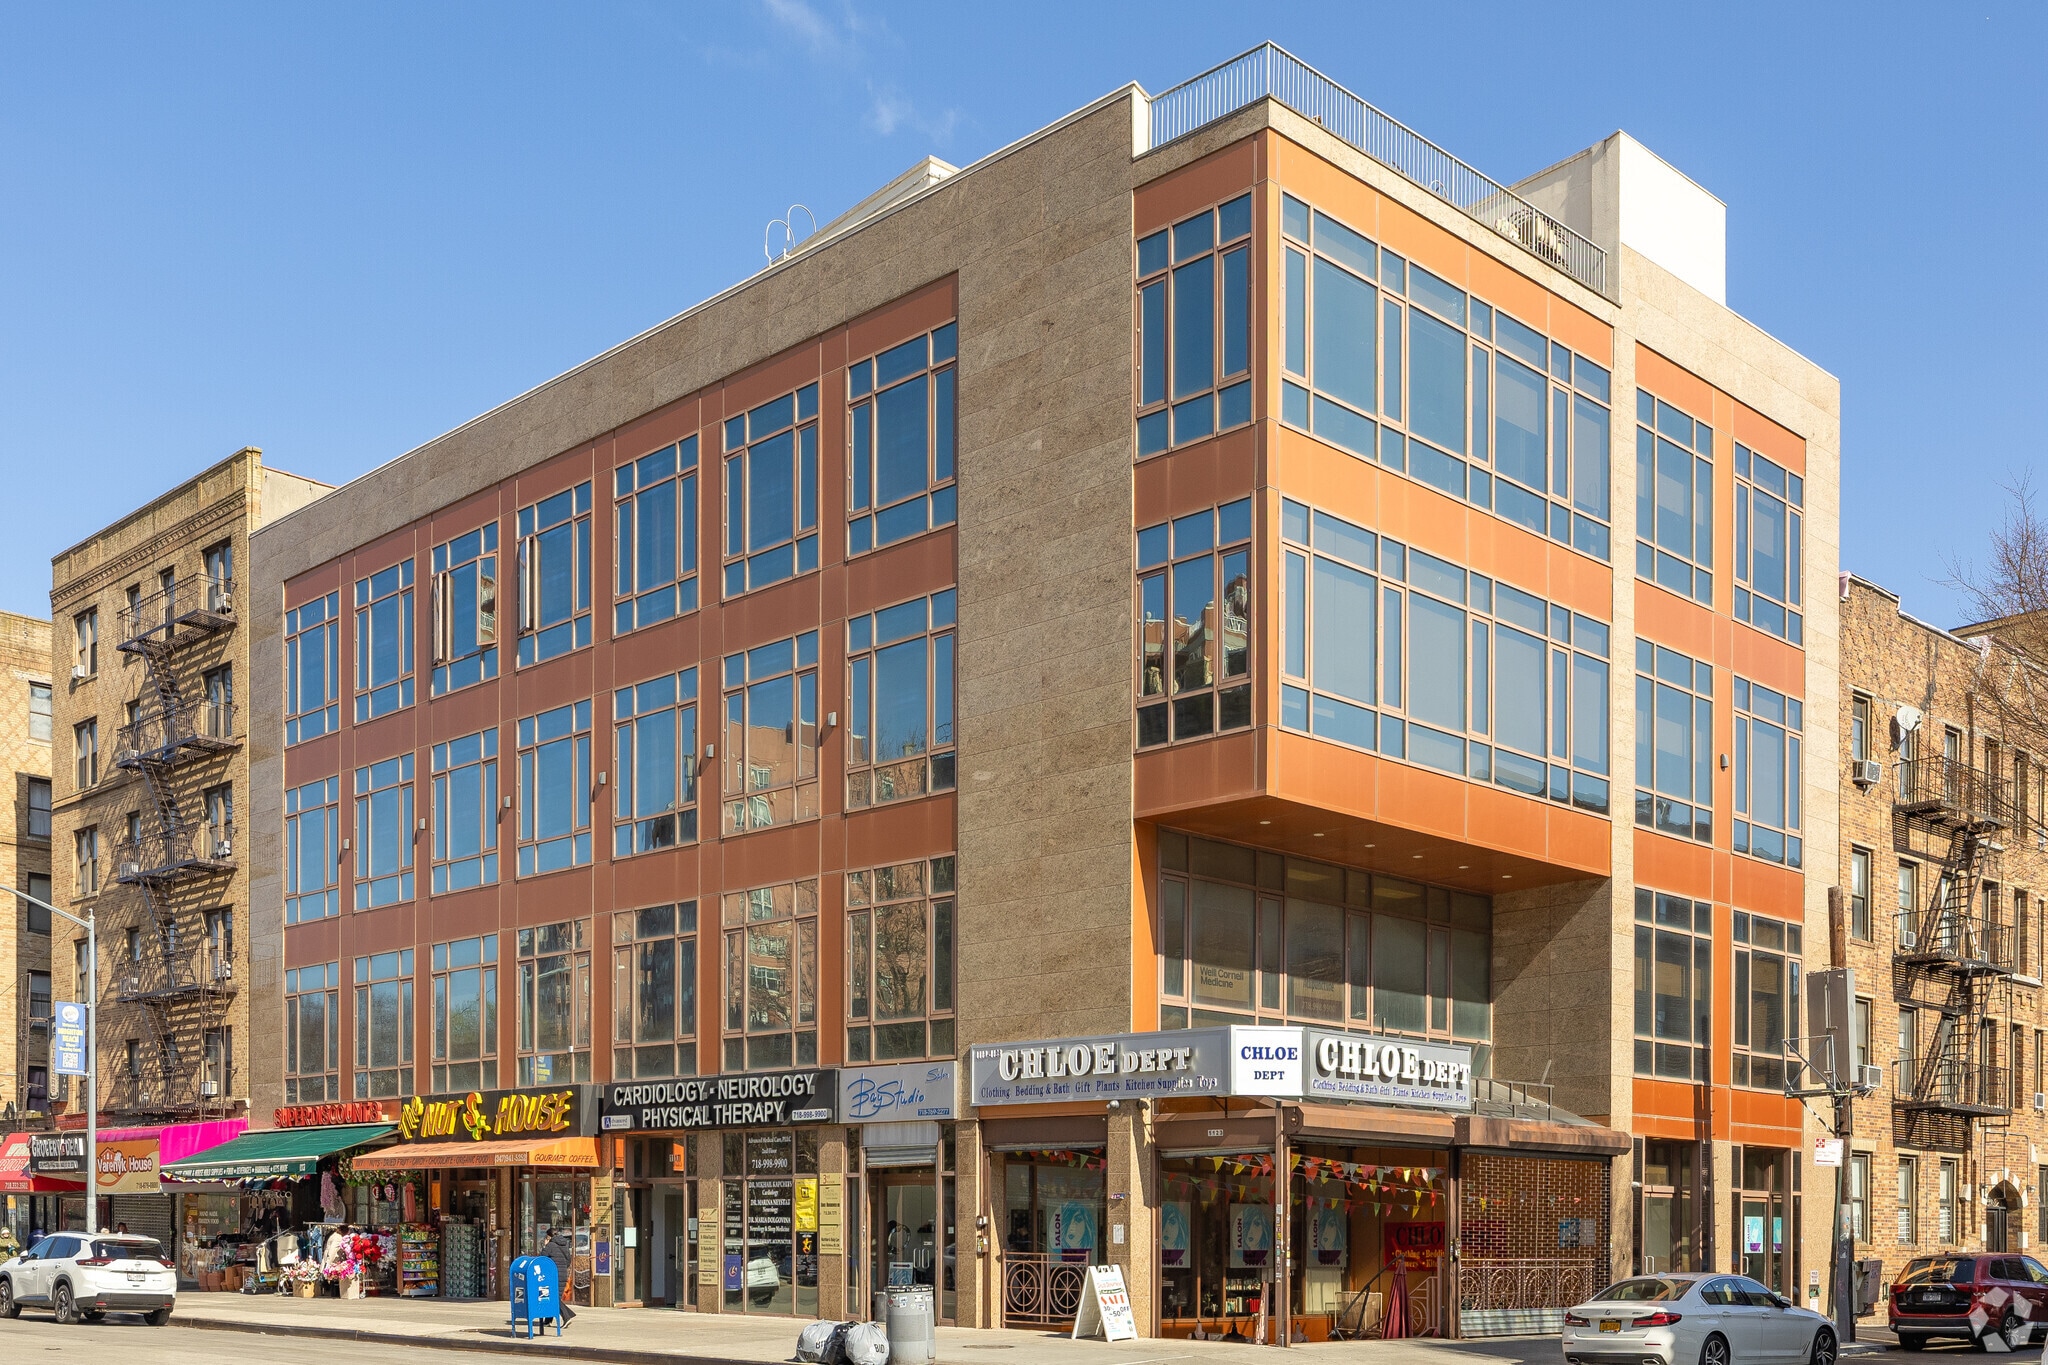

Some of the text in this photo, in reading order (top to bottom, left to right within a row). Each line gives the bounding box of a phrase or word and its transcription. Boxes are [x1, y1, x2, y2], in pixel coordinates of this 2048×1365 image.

[1200, 976, 1233, 988] Medicine
[1217, 968, 1244, 981] Cornell
[1000, 1042, 1190, 1081] CHLOE DEPT
[1241, 1046, 1298, 1061] CHLOE
[1319, 1037, 1472, 1085] CHLOE DEPT
[1254, 1070, 1285, 1080] DEPT
[613, 1081, 707, 1107] CARDIOLOGY
[717, 1073, 815, 1100] NEUROLOGY
[981, 1075, 1217, 1099] Clothing Bedding & Bath Gift Plants Kitchen Supplies Toys
[1312, 1079, 1336, 1093] Clothing
[1338, 1081, 1359, 1094] Bedding
[1365, 1084, 1377, 1094] Bath
[1379, 1085, 1390, 1095] Gift
[1393, 1087, 1409, 1097] Plants
[1411, 1088, 1430, 1099] Kitchen
[1432, 1090, 1453, 1102] Supplies
[1455, 1092, 1467, 1103] Toys
[420, 1100, 464, 1138] NUT
[493, 1090, 574, 1135] HOUSE
[642, 1101, 785, 1128] PHYSICAL THERAPY
[97, 1156, 127, 1175] Varenyk
[129, 1156, 153, 1171] House
[534, 1153, 594, 1164] GOURMET COFFEE
[752, 1159, 788, 1168] 718-998-9900
[1396, 1225, 1445, 1247] CHLO
